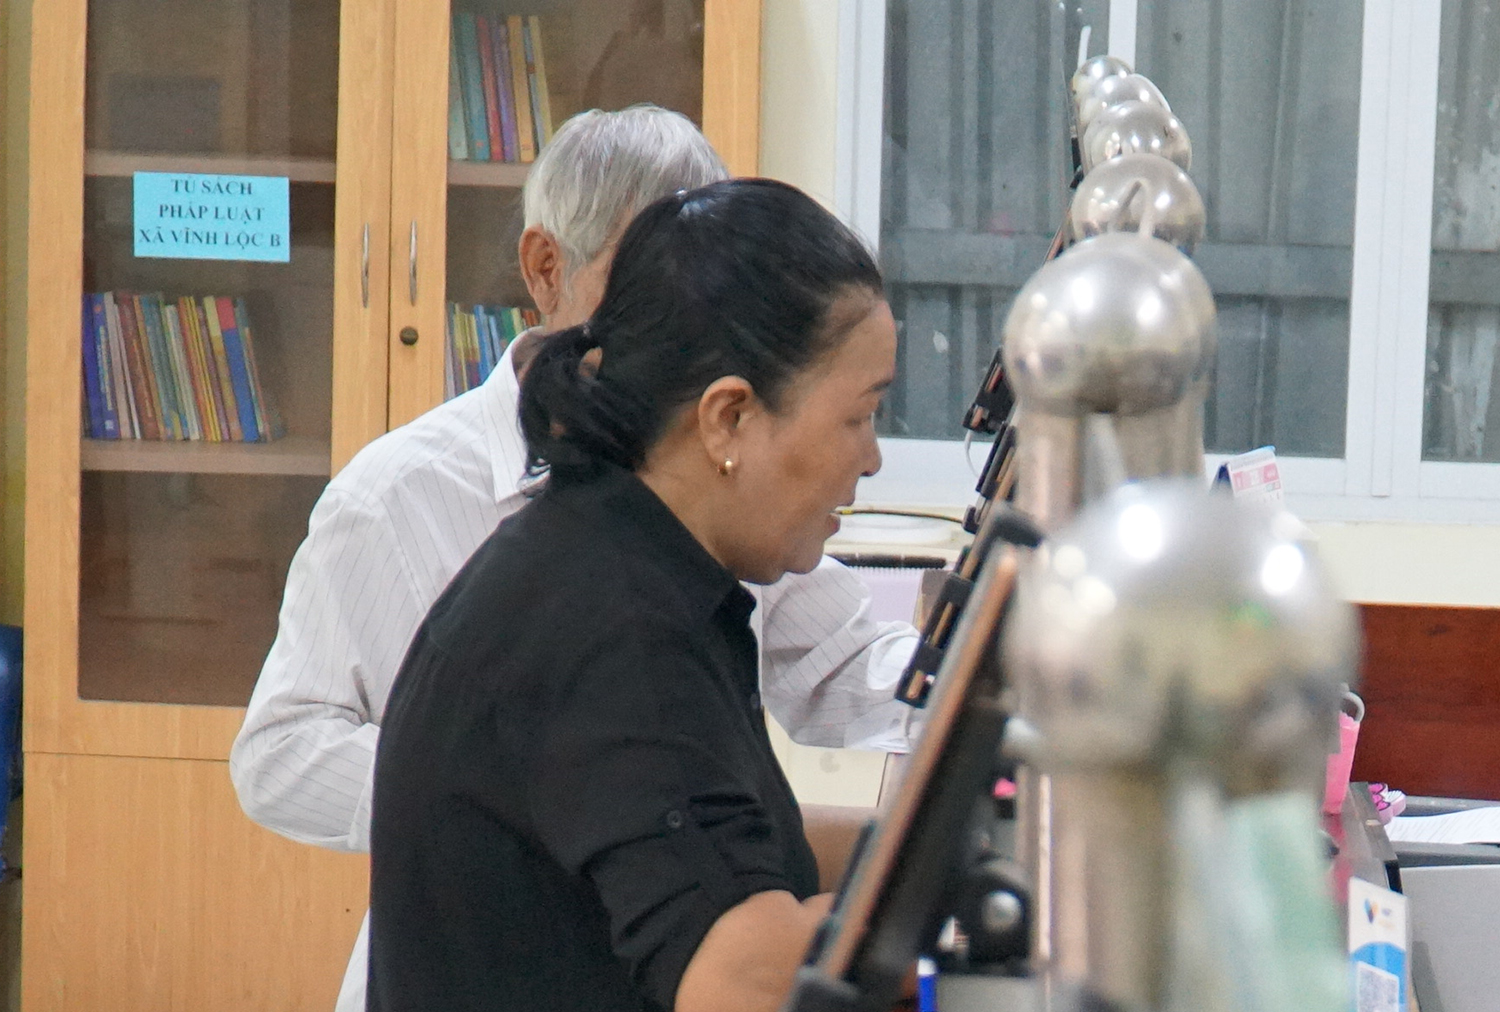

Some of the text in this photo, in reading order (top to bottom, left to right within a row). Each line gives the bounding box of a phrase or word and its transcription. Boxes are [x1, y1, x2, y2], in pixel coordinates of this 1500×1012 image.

[201, 176, 253, 195] SÁCH
[159, 201, 208, 219] PHÁP
[139, 226, 165, 244] XÃ
[270, 233, 281, 247] B
